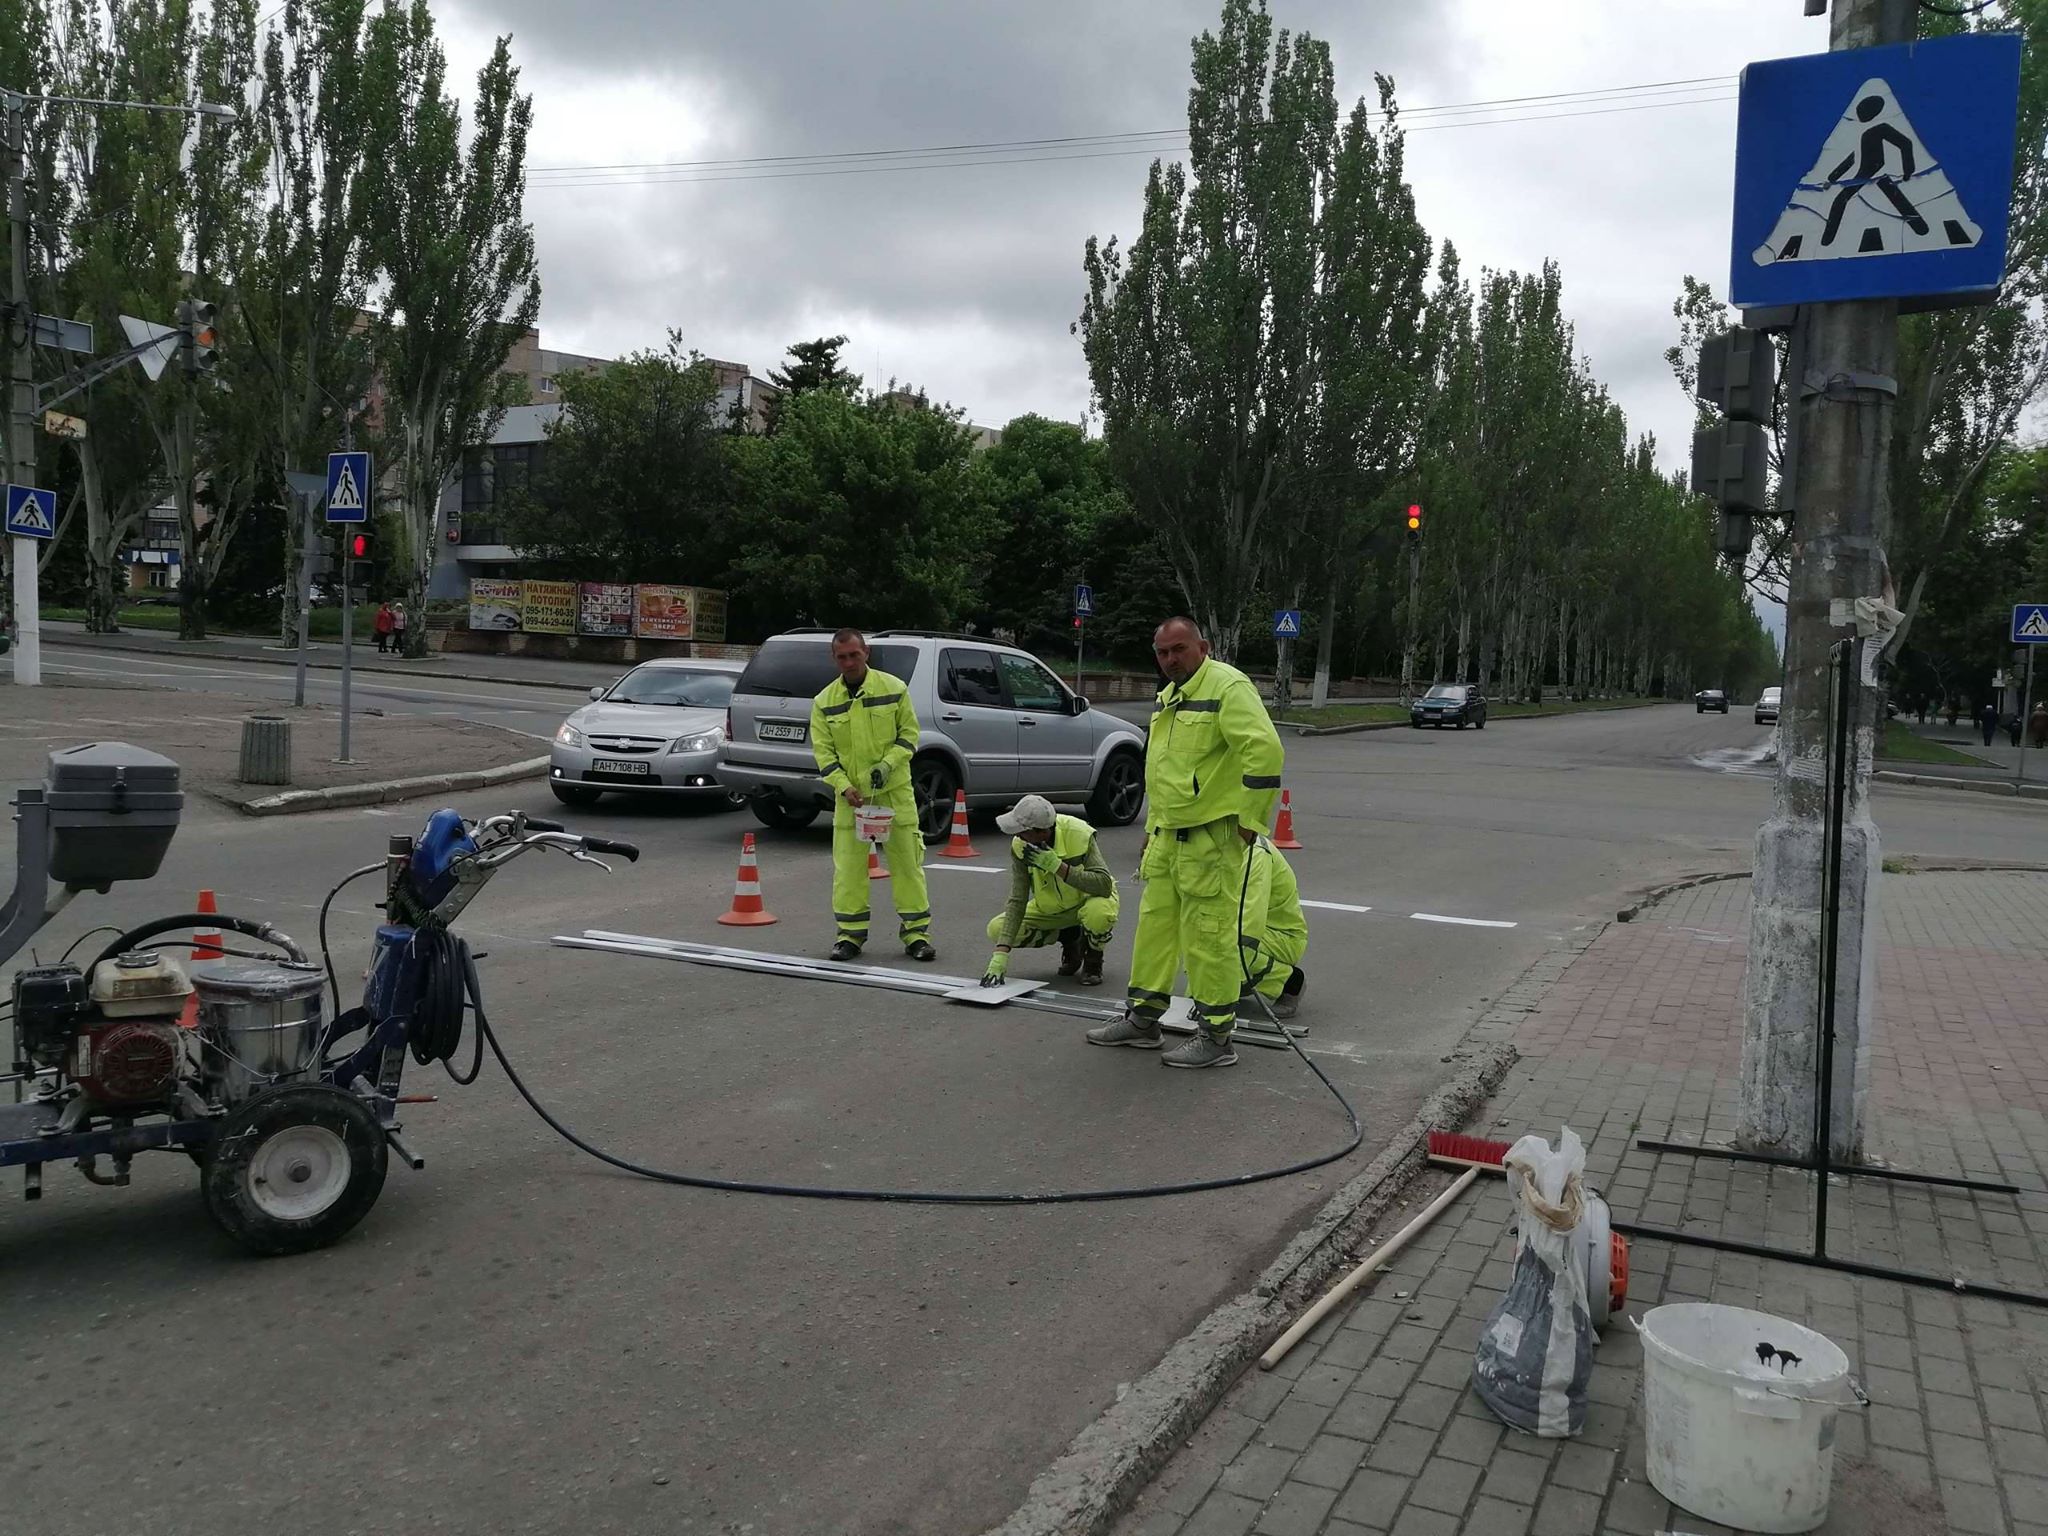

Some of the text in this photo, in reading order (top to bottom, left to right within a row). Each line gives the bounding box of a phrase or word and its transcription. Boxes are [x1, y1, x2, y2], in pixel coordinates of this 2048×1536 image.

[526, 583, 575, 596] НАТЯЖНЫЕ
[530, 595, 571, 607] ПОТОЛКИ
[525, 606, 575, 617] 095-171-60-35
[764, 725, 803, 739] AH 2559 IP
[598, 761, 647, 773] AH 7108 HB
